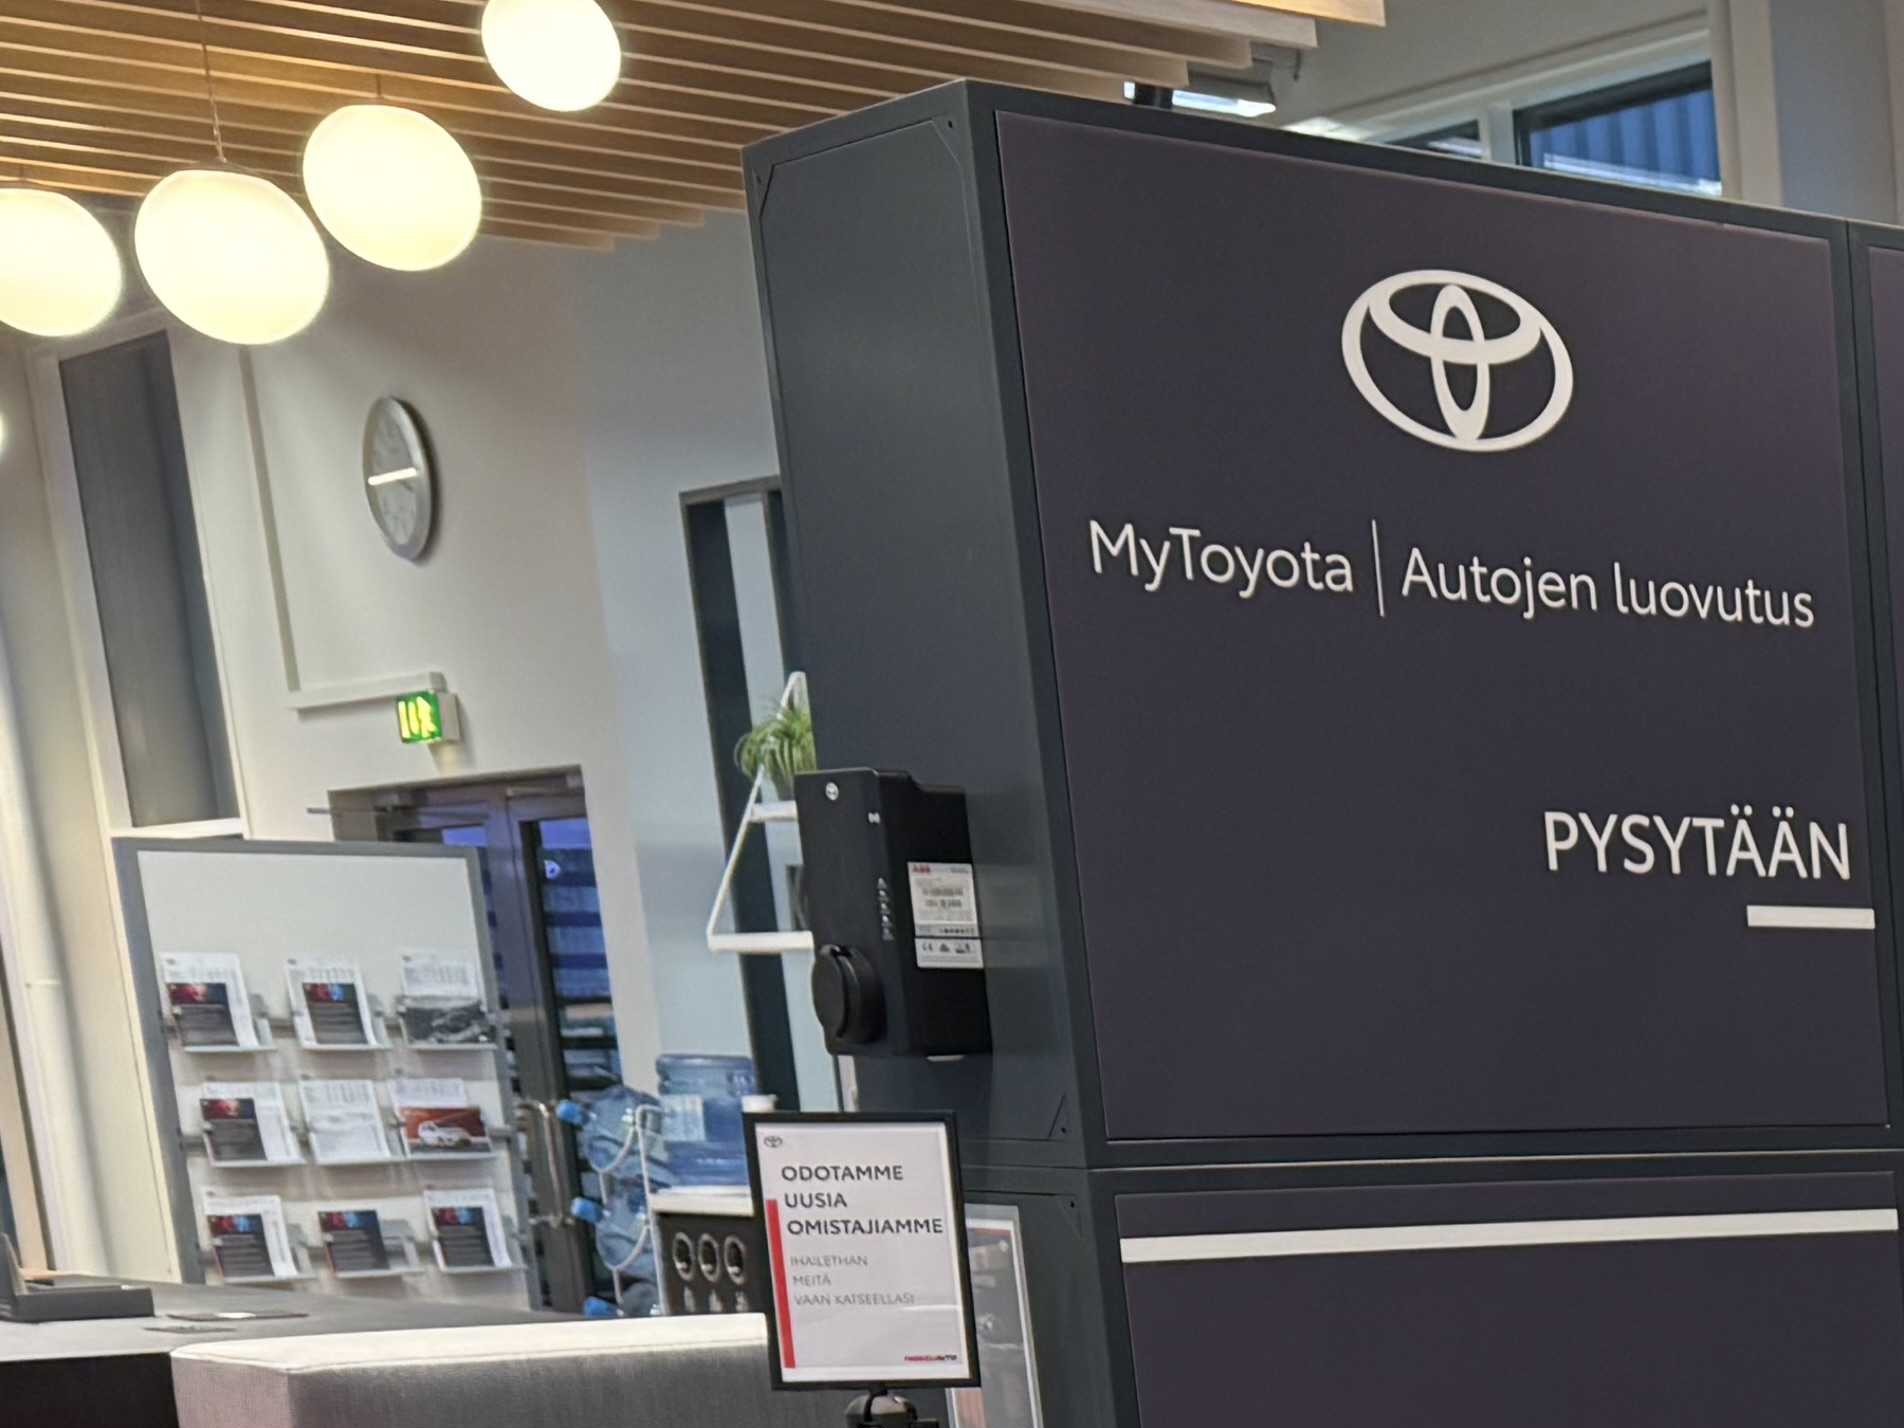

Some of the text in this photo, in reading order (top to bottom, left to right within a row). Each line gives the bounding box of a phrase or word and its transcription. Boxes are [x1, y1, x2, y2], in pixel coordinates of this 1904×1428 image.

[1089, 520, 1814, 628] MyToyota Autojen luovutus
[1544, 804, 1850, 880] PYSYTÄÄN
[781, 1165, 904, 1181] ODOTAMME
[785, 1192, 848, 1209] UUSIA
[787, 1218, 944, 1235] OMISTAJIAMME
[792, 1273, 832, 1287] MEITÄ
[795, 1292, 915, 1306] VAAN KATSEELLASI
